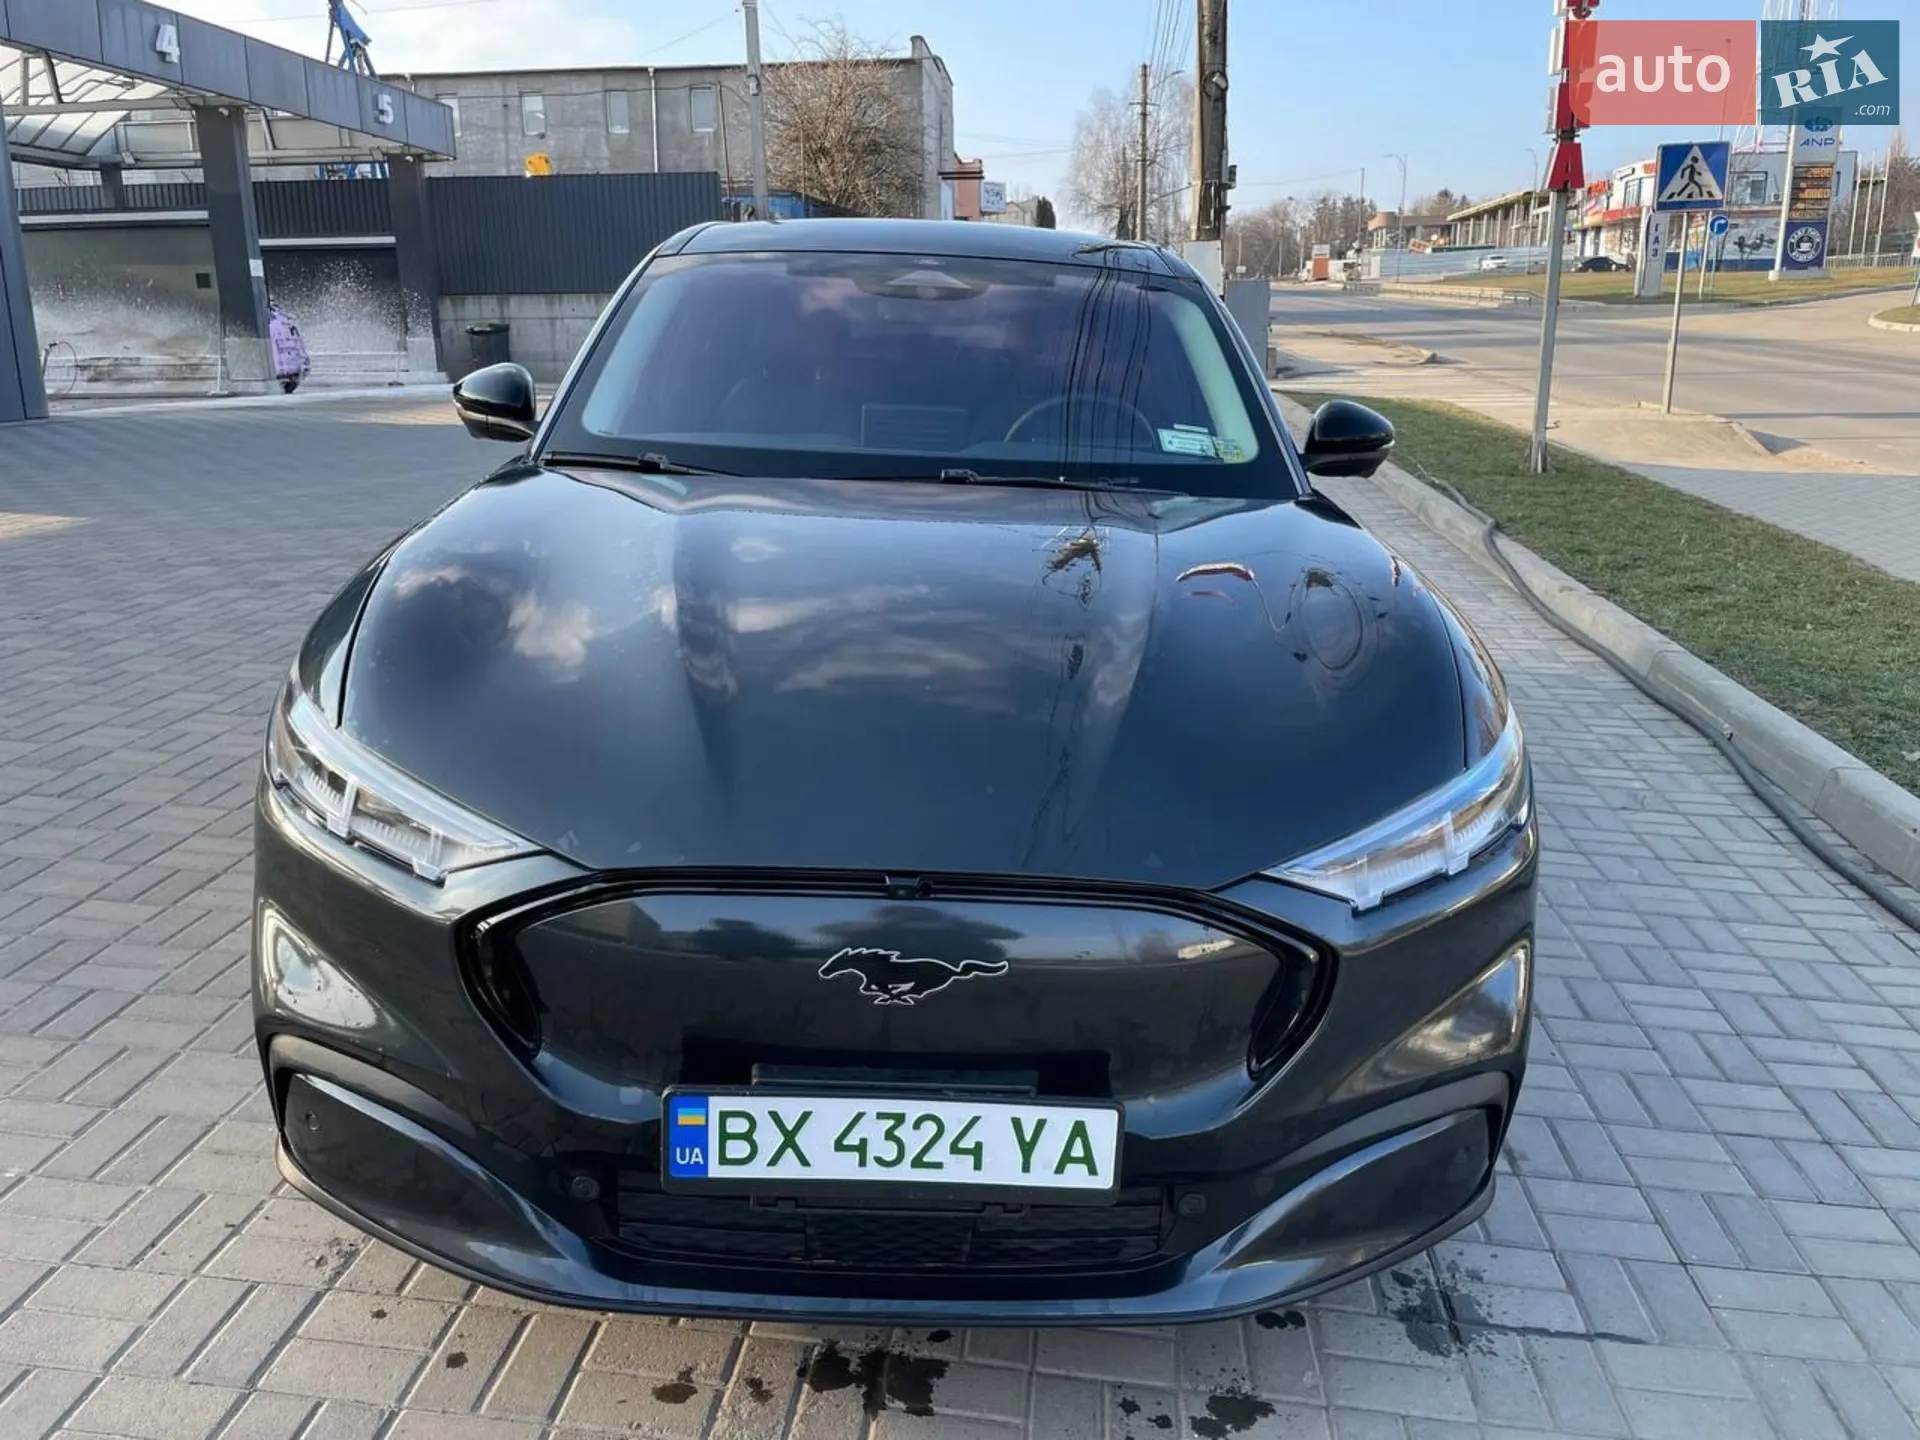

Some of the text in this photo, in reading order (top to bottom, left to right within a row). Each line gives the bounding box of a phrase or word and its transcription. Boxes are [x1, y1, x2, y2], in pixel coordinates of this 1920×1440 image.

[156, 23, 180, 64] 4
[376, 93, 394, 125] 5
[1799, 137, 1835, 147] ANP
[1652, 223, 1661, 257] ГАЗ
[676, 1148, 704, 1165] UA
[717, 1110, 1099, 1176] BX 4324 YA
